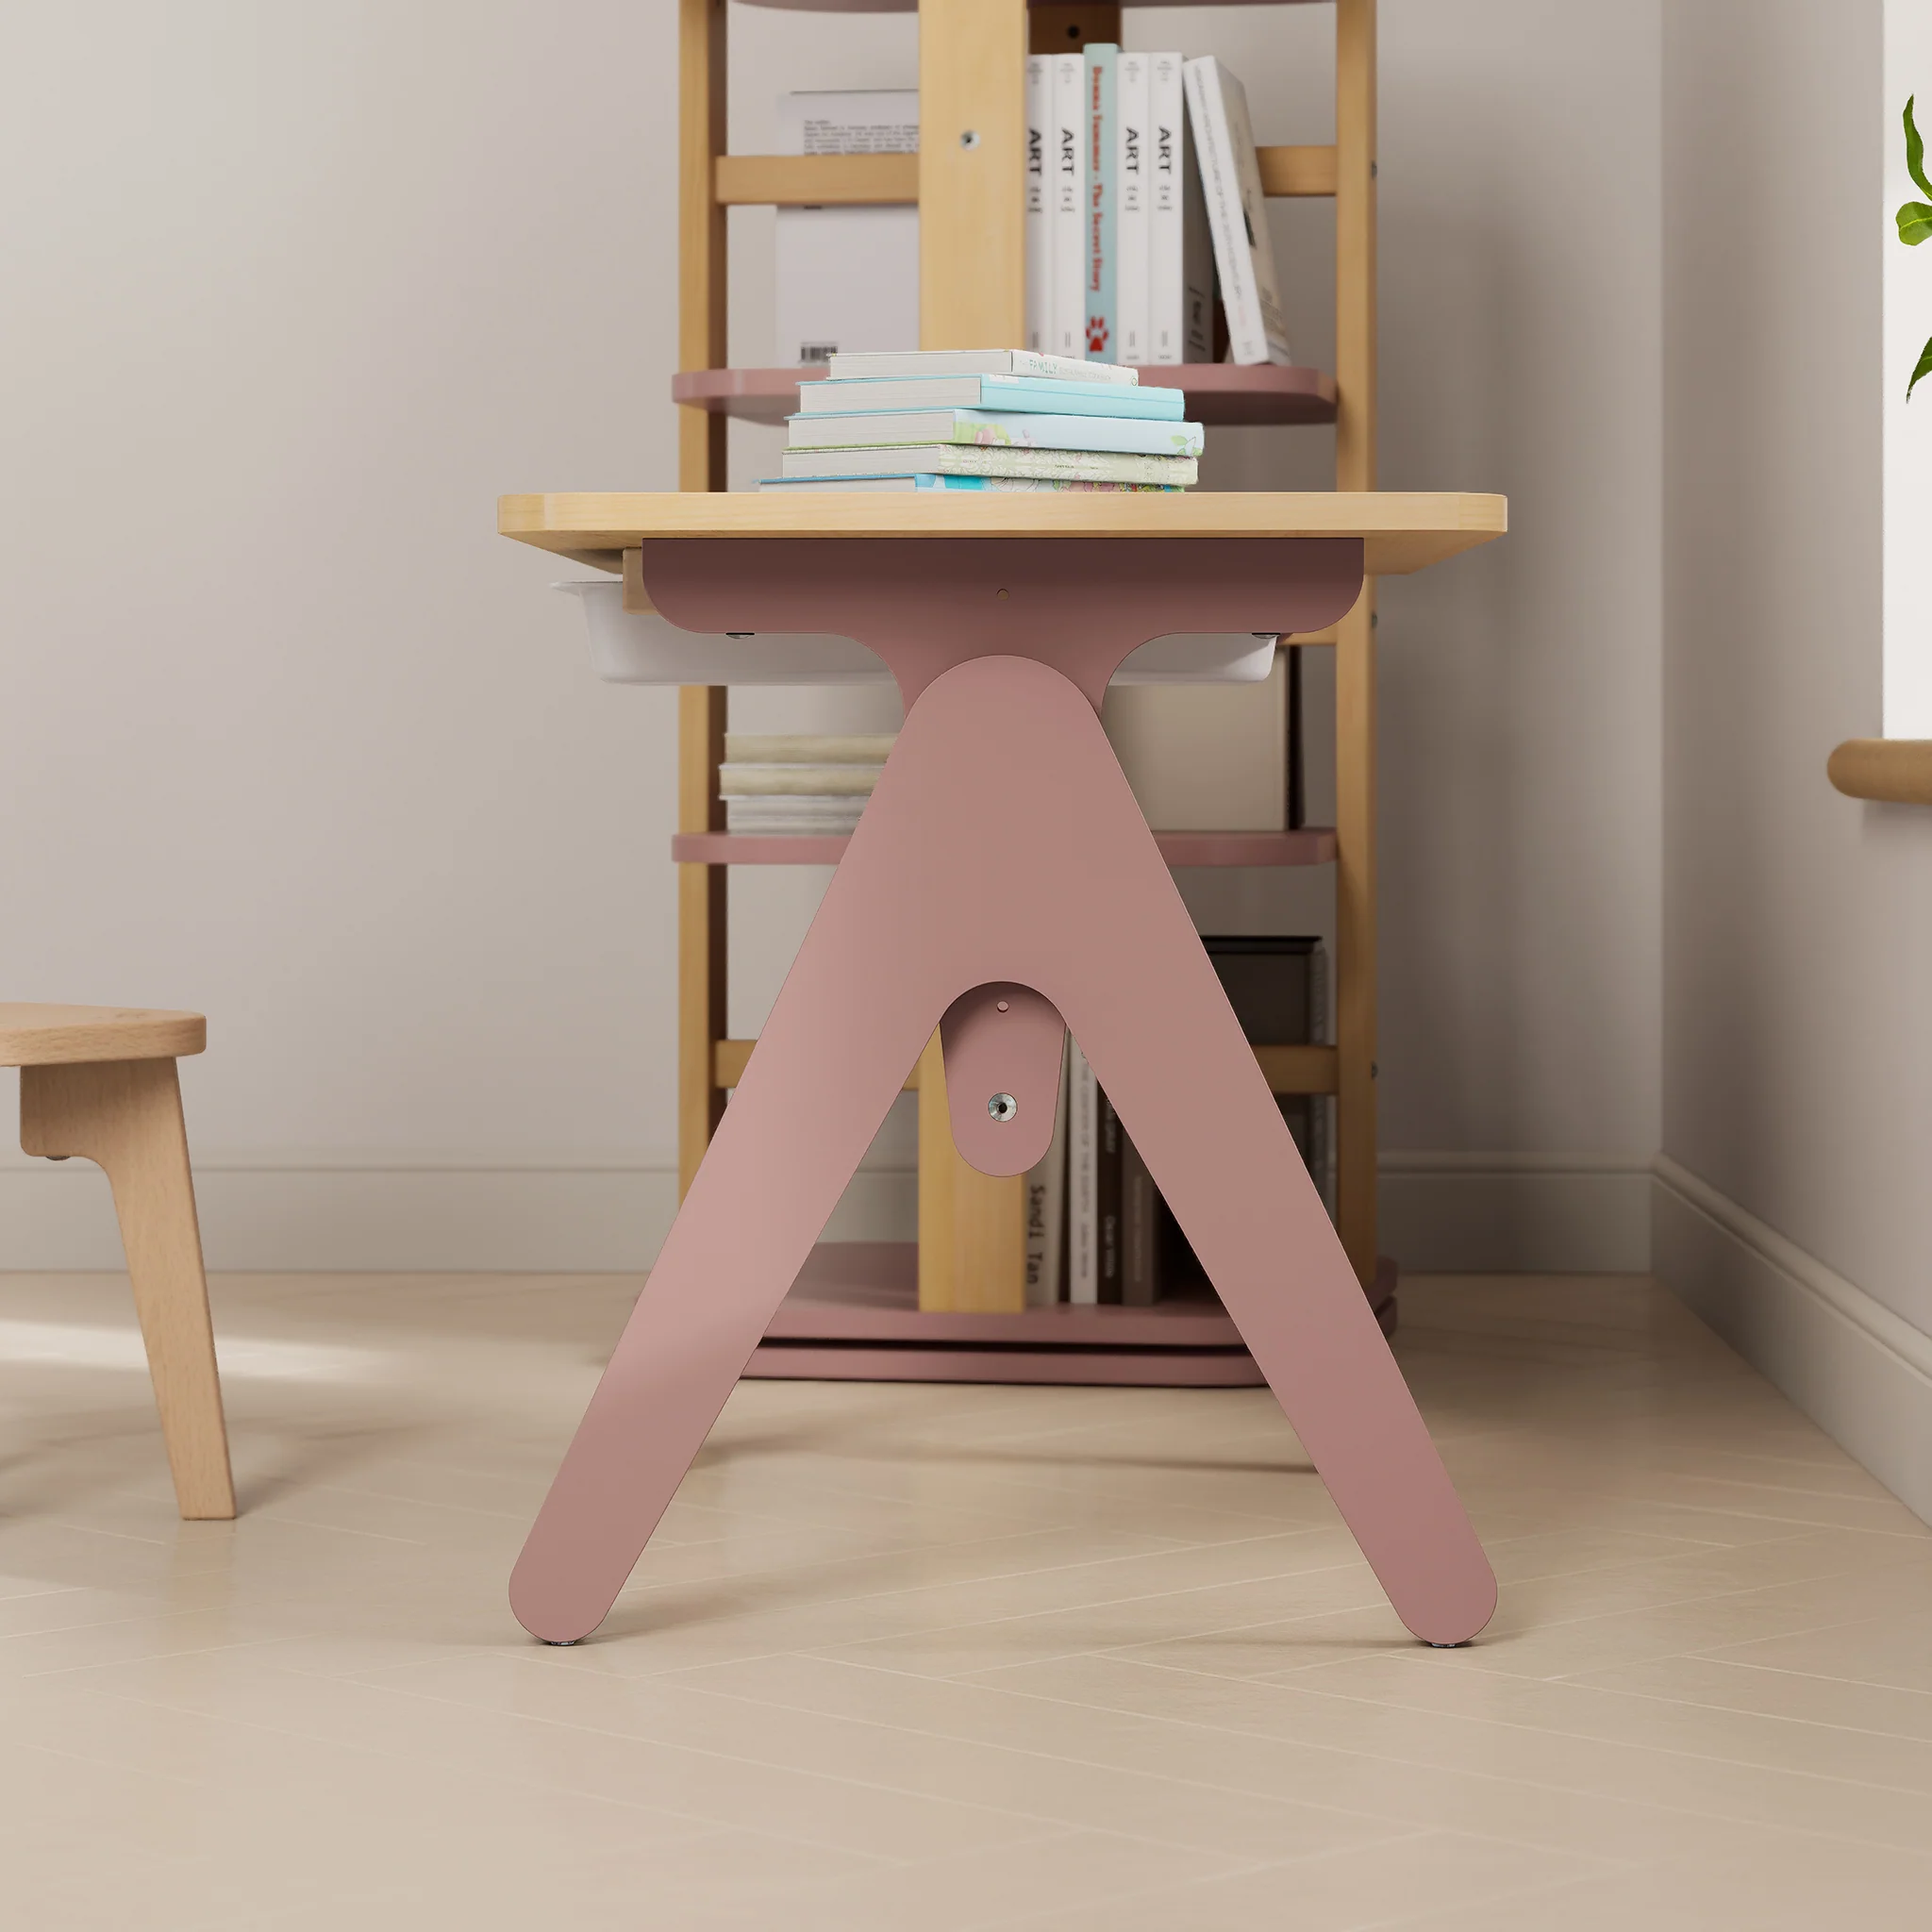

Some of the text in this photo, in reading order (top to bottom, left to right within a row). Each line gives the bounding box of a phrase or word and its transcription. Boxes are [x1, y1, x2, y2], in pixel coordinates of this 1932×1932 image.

[1028, 126, 1042, 177] ART
[1061, 126, 1074, 176] ART
[1126, 125, 1140, 175] ART
[1158, 125, 1172, 175] ART
[1029, 359, 1058, 375] FAMILY
[1026, 1184, 1046, 1285] Sandi Tan
